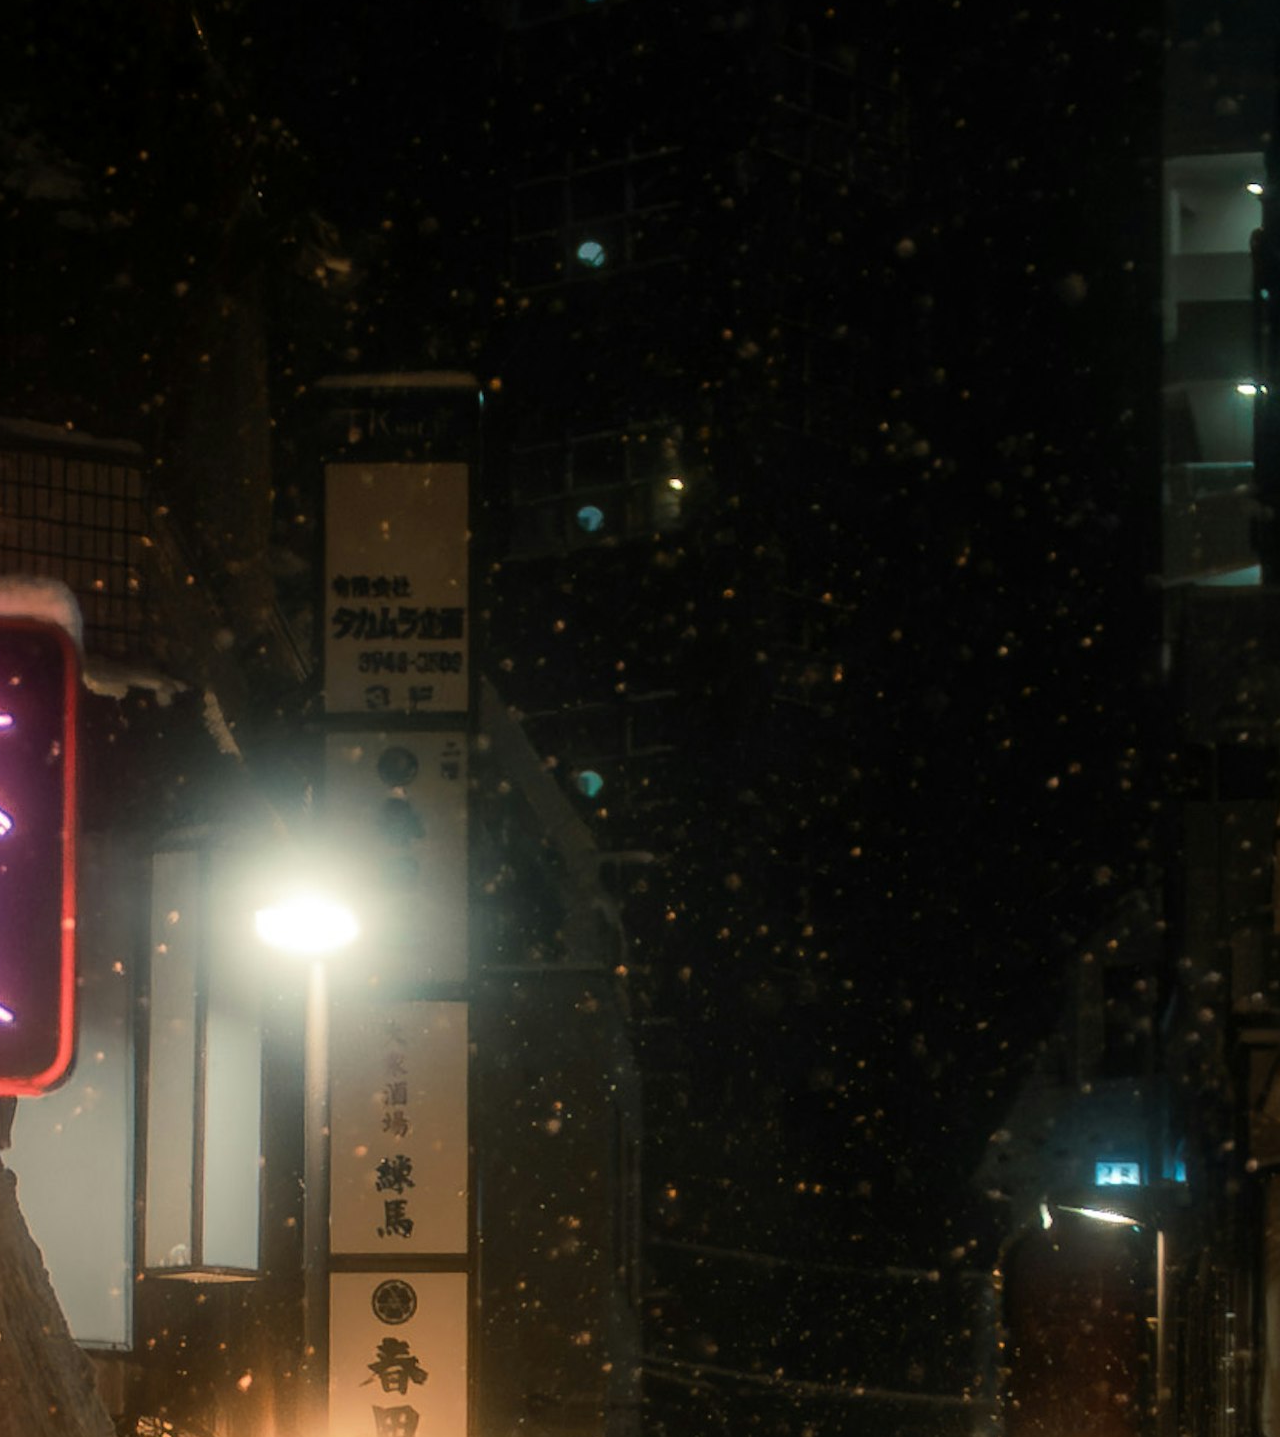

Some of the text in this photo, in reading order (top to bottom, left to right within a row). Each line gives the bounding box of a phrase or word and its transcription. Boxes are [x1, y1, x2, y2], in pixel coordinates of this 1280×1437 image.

[332, 573, 412, 598] 有限会社
[375, 1155, 417, 1239] 練馬
